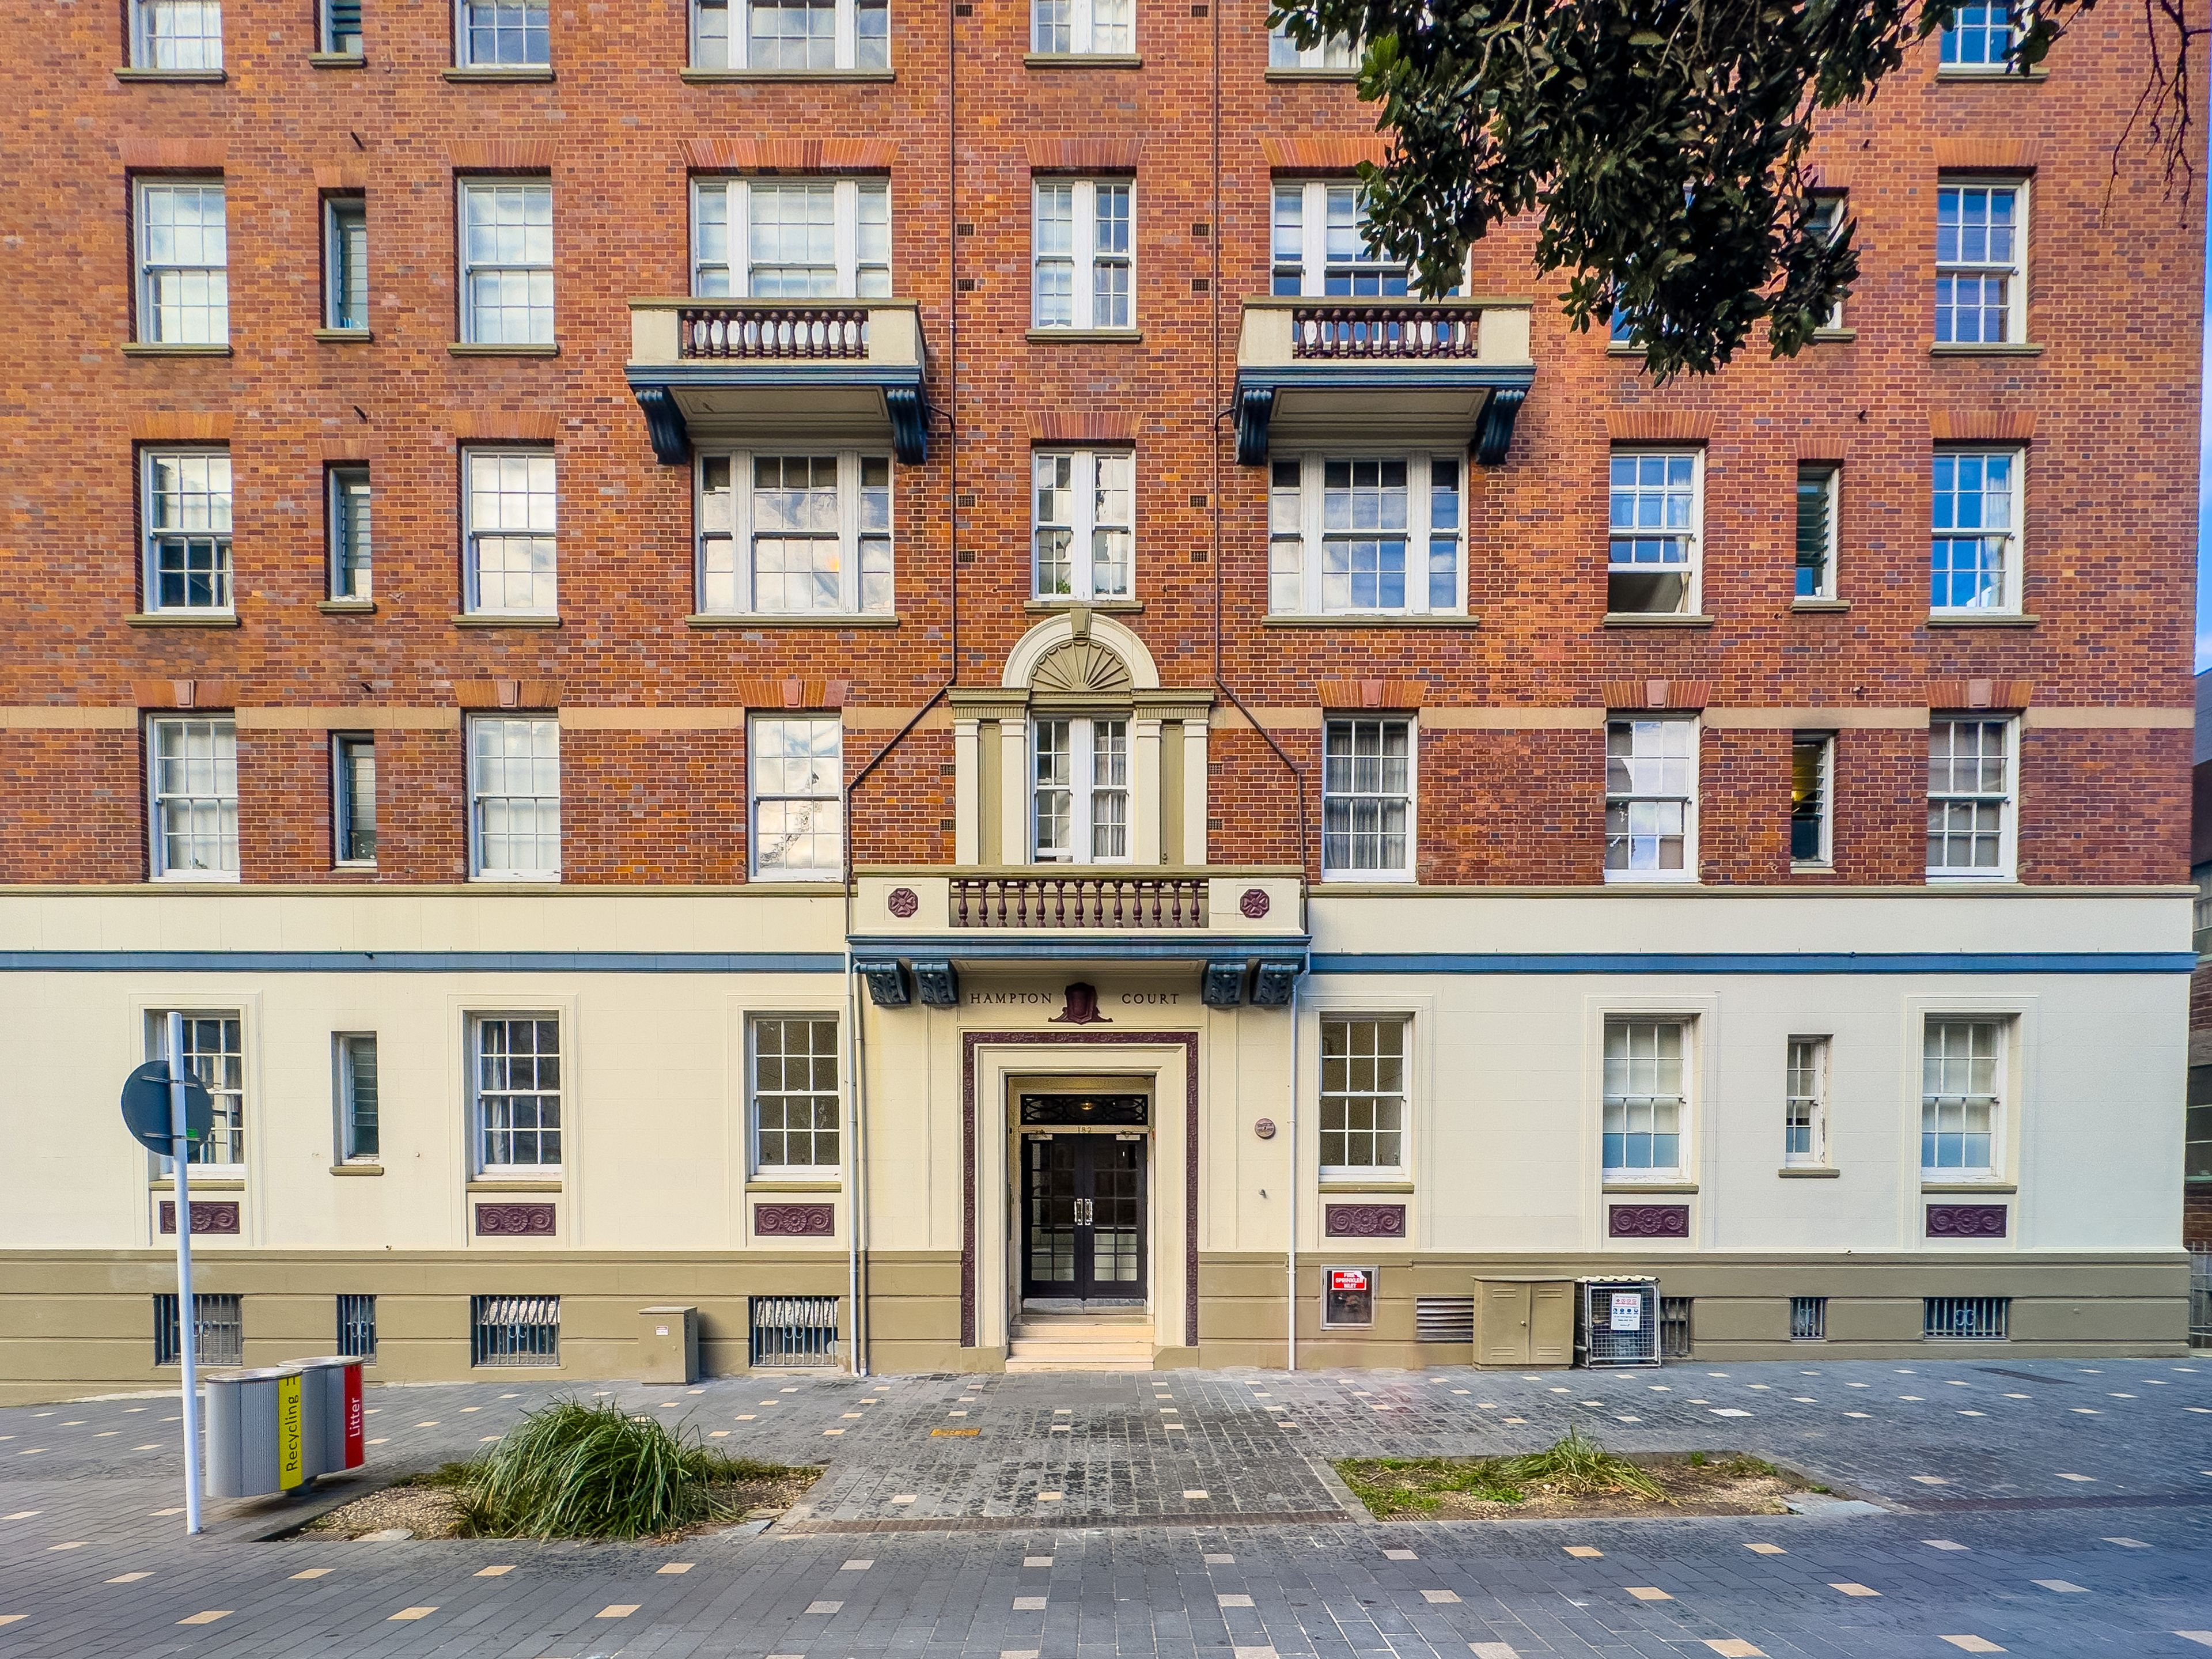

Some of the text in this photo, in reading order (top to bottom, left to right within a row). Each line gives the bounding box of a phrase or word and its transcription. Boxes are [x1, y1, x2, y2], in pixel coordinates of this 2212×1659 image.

[969, 993, 1180, 1005] HAMPTON COURT
[285, 1395, 300, 1472] Recycling
[349, 1397, 361, 1437] Litter
